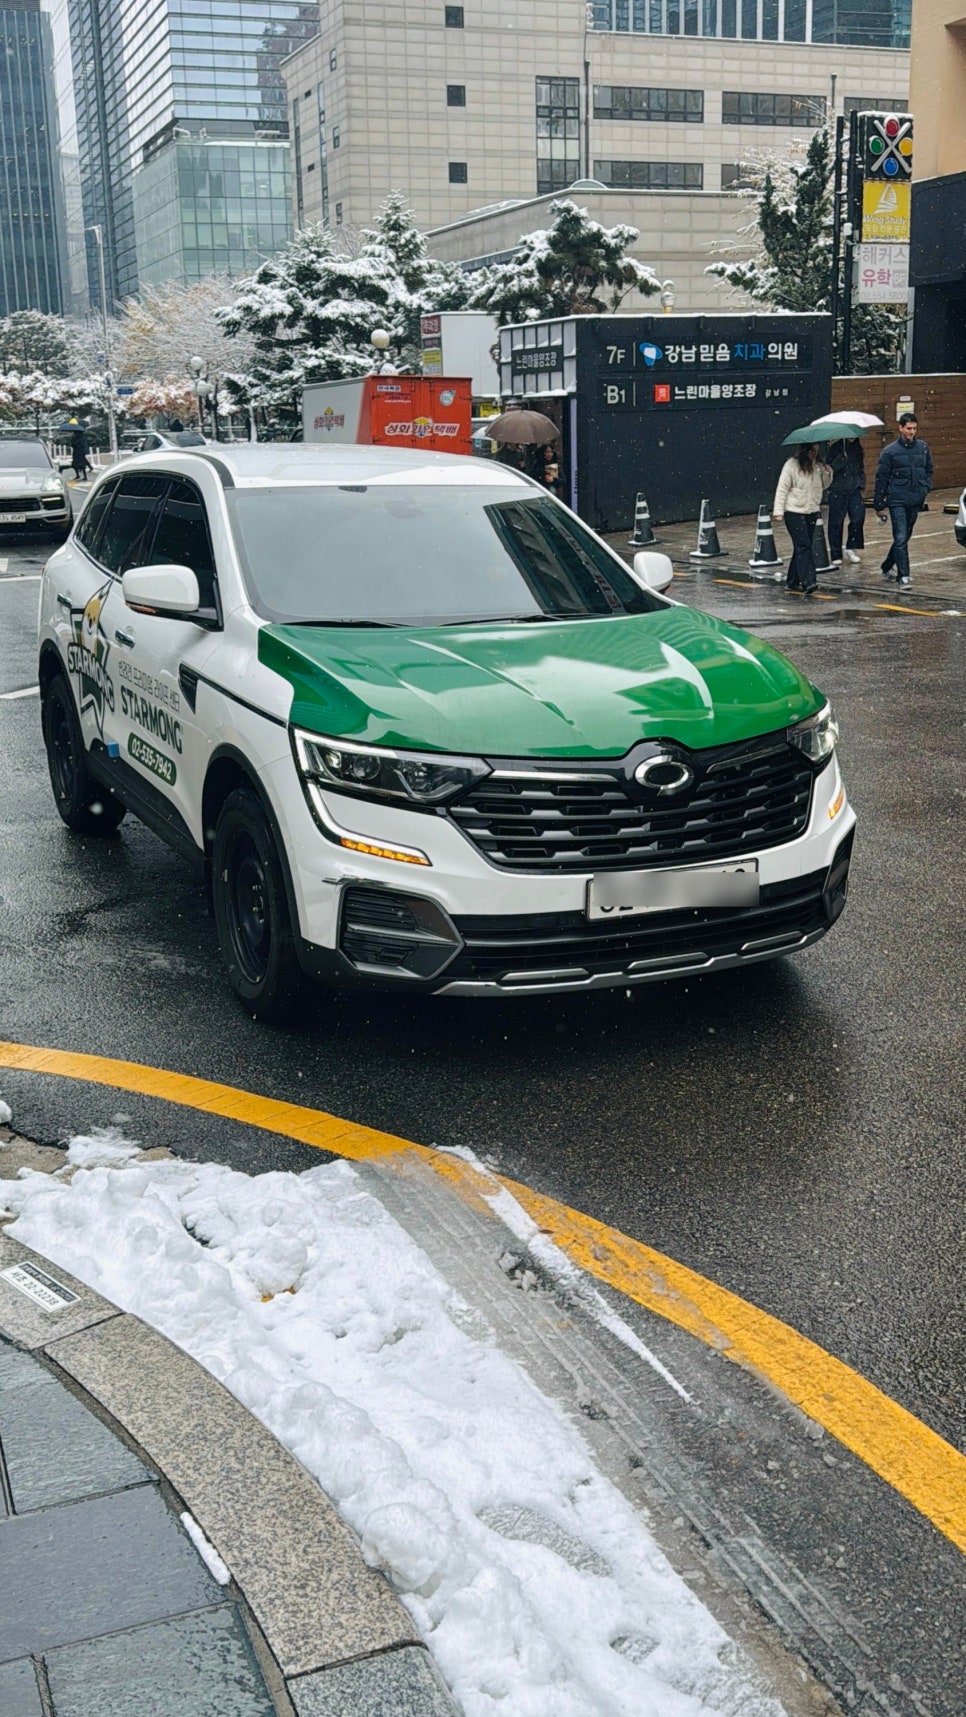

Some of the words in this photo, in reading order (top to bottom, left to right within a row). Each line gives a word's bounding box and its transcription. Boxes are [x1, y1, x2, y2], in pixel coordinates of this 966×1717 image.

[862, 246, 908, 265] 해커스
[862, 268, 891, 288] 유학
[516, 351, 557, 369] 느린마을양조장
[606, 345, 626, 364] 7F
[606, 385, 626, 404] B1
[674, 384, 757, 400] 느린마을양조장
[68, 648, 114, 712] STARMONG
[120, 684, 183, 755] STARMONG
[131, 737, 173, 780] 02-535-7942
